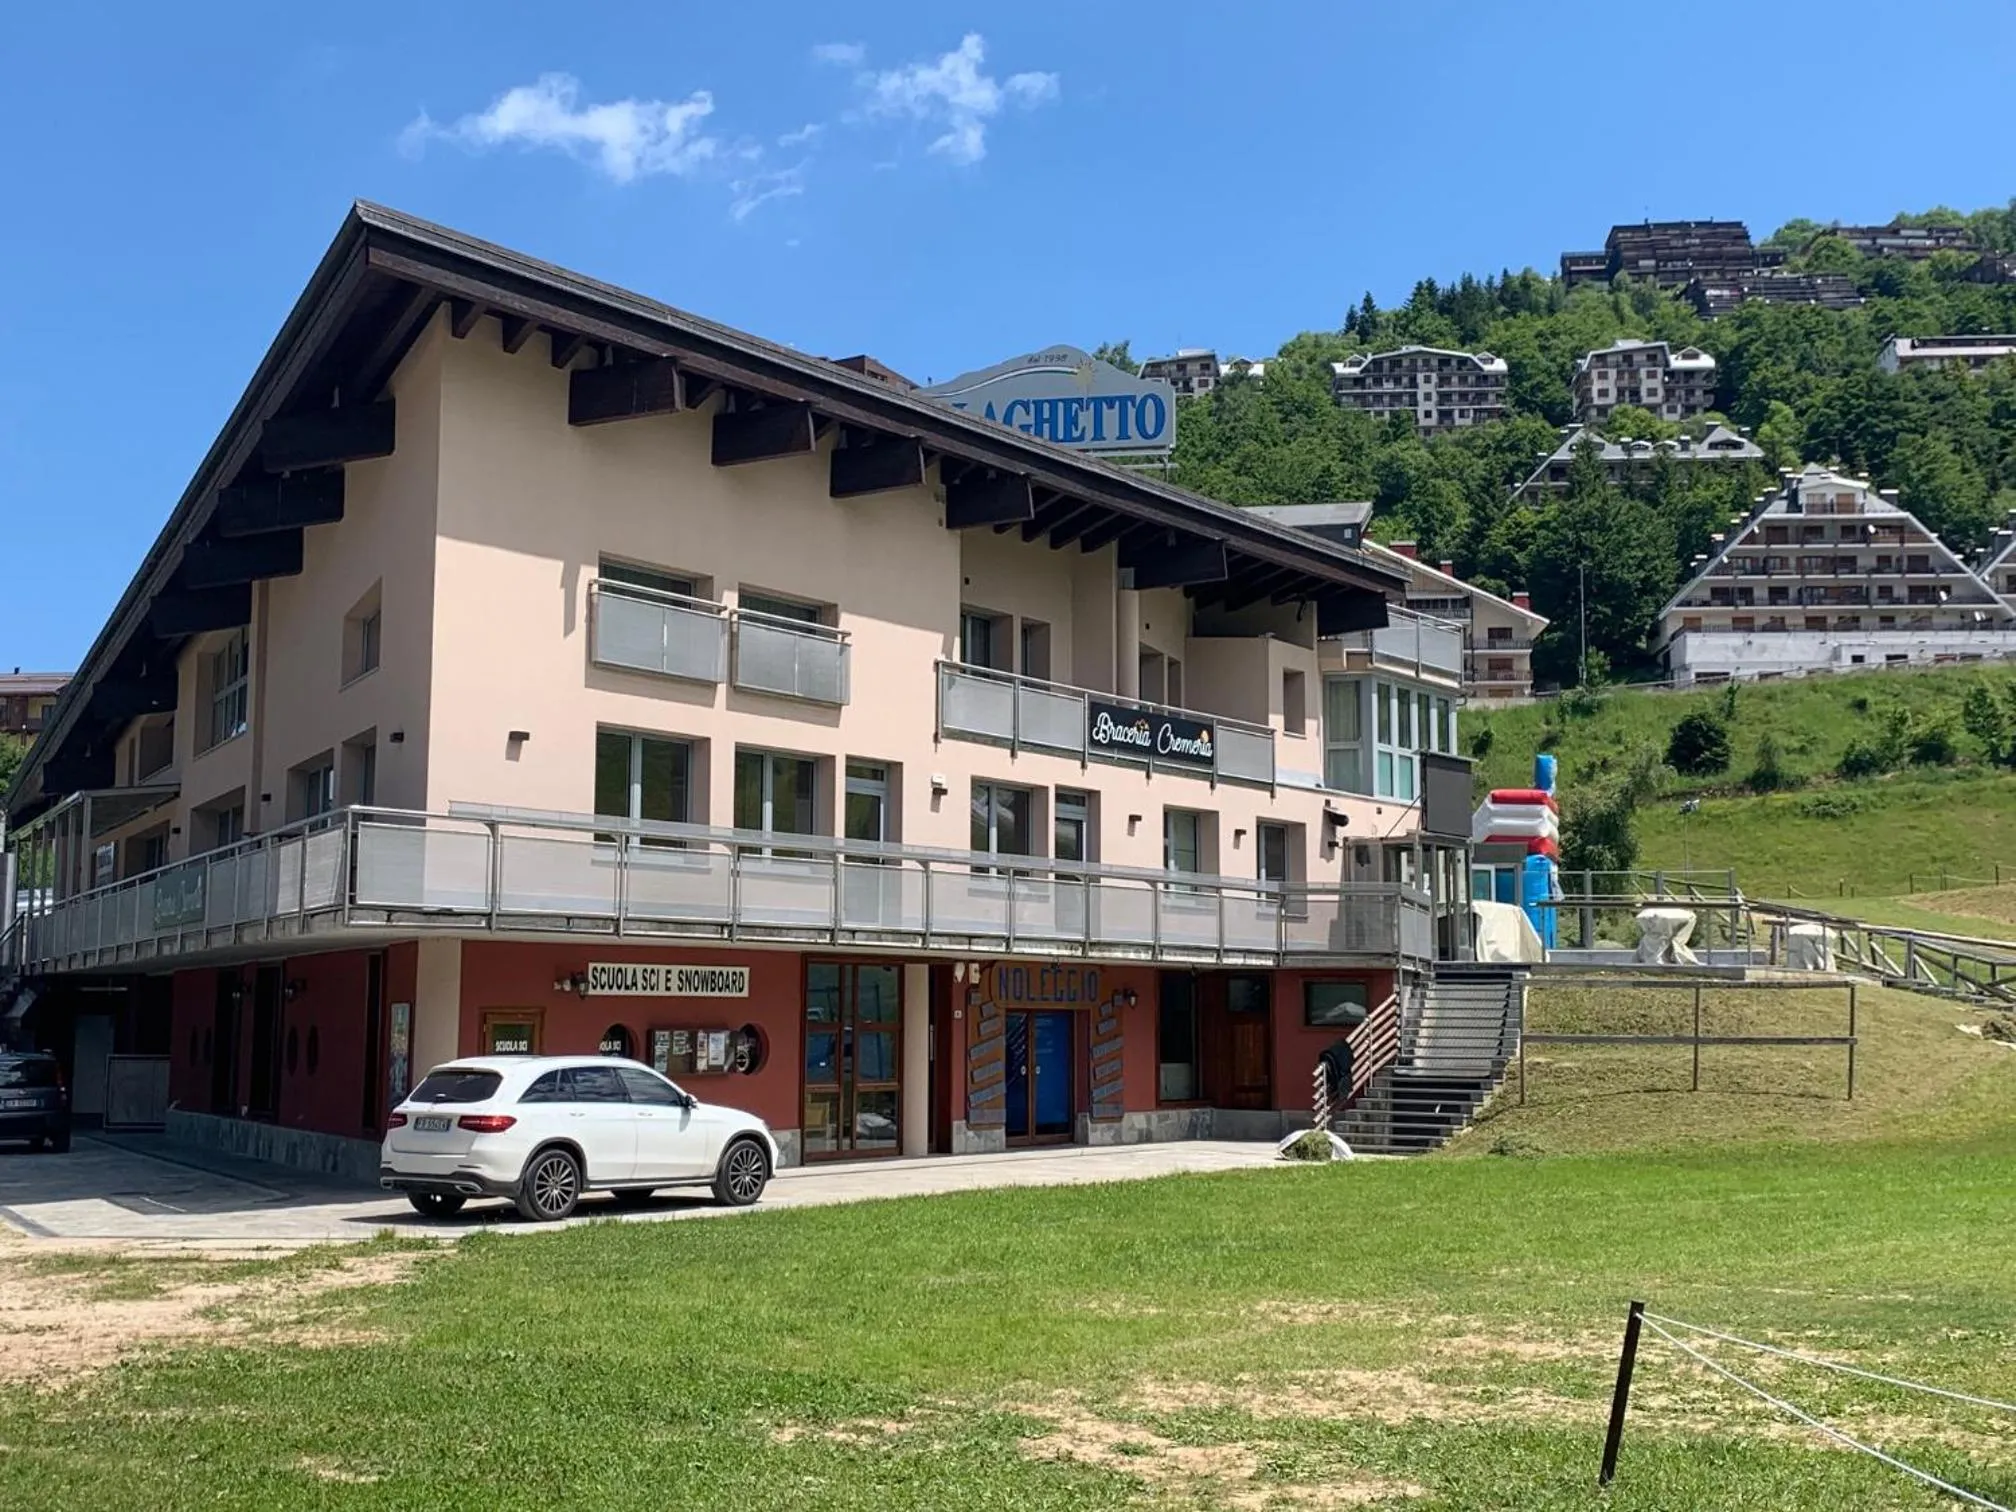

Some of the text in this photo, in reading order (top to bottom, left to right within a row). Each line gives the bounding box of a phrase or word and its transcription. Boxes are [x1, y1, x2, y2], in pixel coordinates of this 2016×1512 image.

[952, 392, 1166, 443] GHETTO
[1092, 712, 1213, 757] Braceria Cremeria
[591, 966, 745, 993] SCUOLA SCI E SNOWBOARD
[999, 967, 1098, 1002] NOLEGGIO
[495, 1040, 528, 1052] SCUOLA SCI
[599, 1040, 612, 1052] OLA
